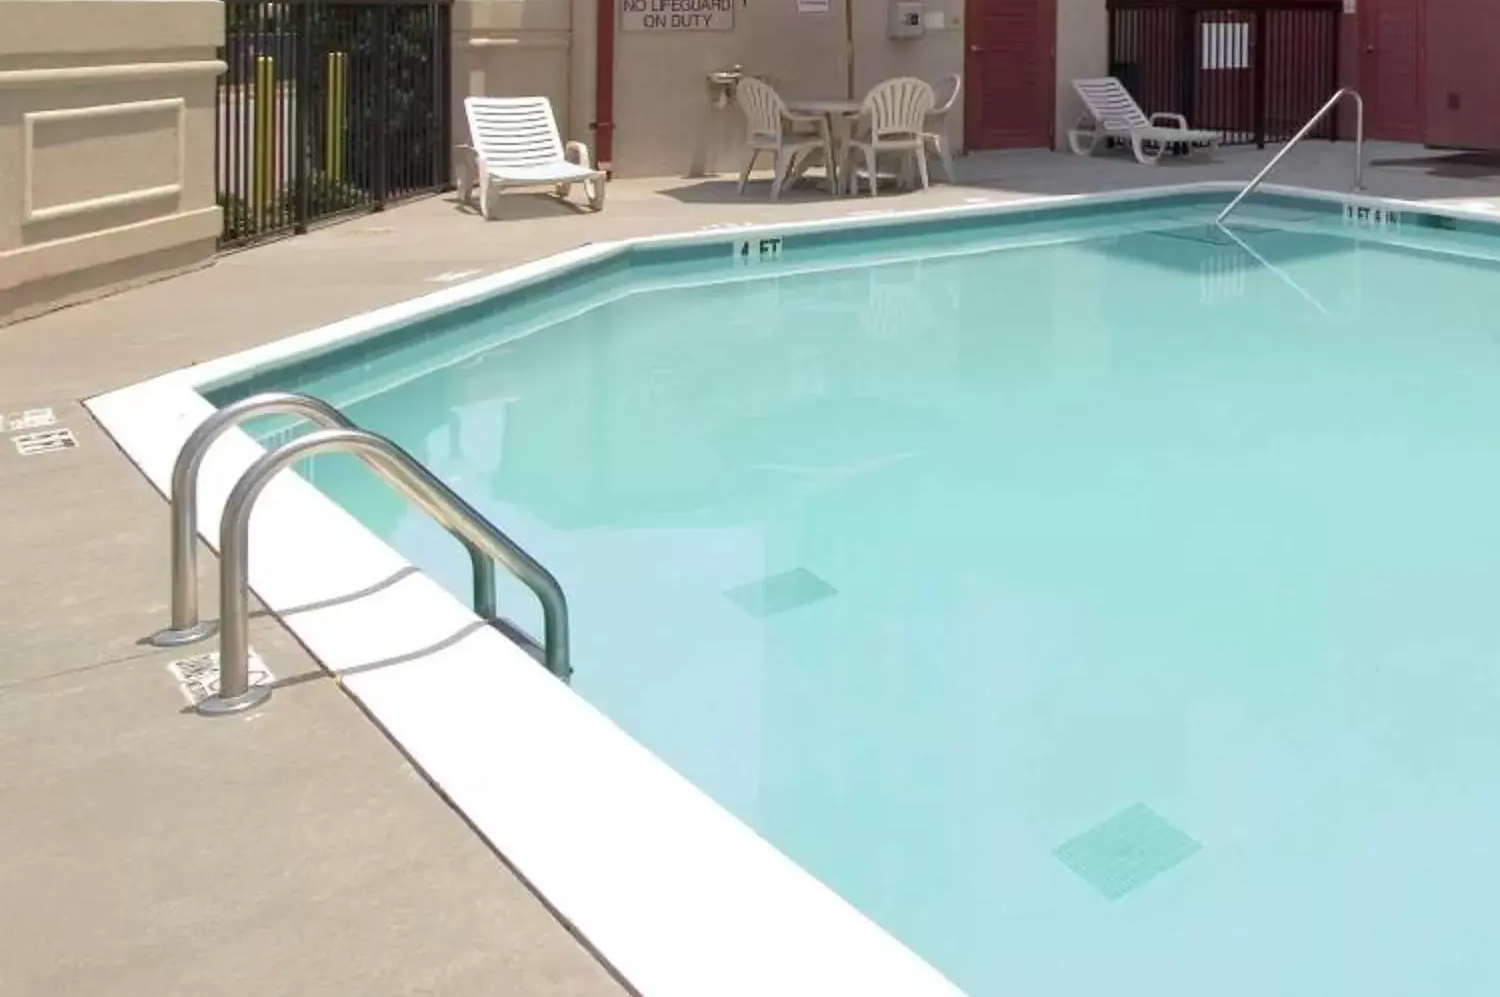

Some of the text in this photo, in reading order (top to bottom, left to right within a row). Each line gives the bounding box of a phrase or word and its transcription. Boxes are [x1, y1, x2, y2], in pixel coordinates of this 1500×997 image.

[643, 13, 713, 28] ON DUTY
[759, 238, 781, 255] FT
